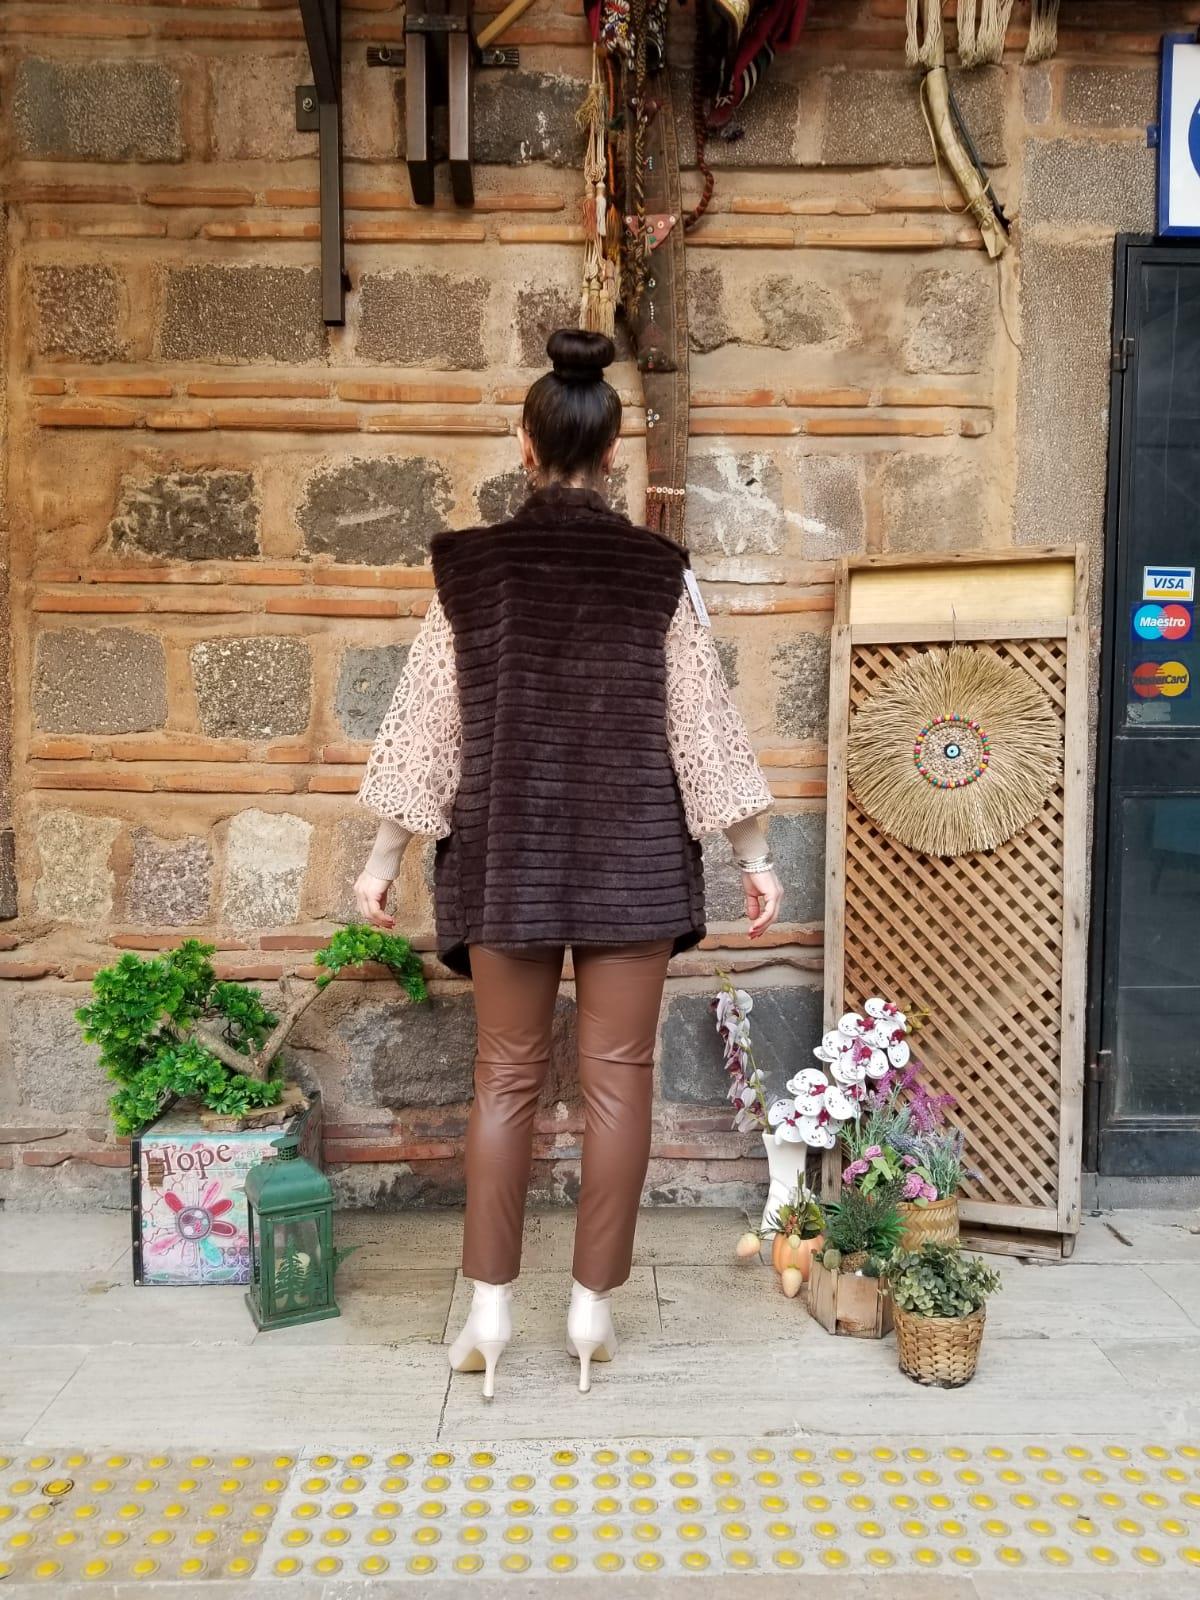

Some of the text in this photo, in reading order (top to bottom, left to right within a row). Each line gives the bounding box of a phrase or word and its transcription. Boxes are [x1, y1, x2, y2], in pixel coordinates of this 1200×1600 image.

[1153, 578, 1184, 589] VISA
[1140, 617, 1186, 627] Maestro
[142, 1144, 233, 1180] Hope
